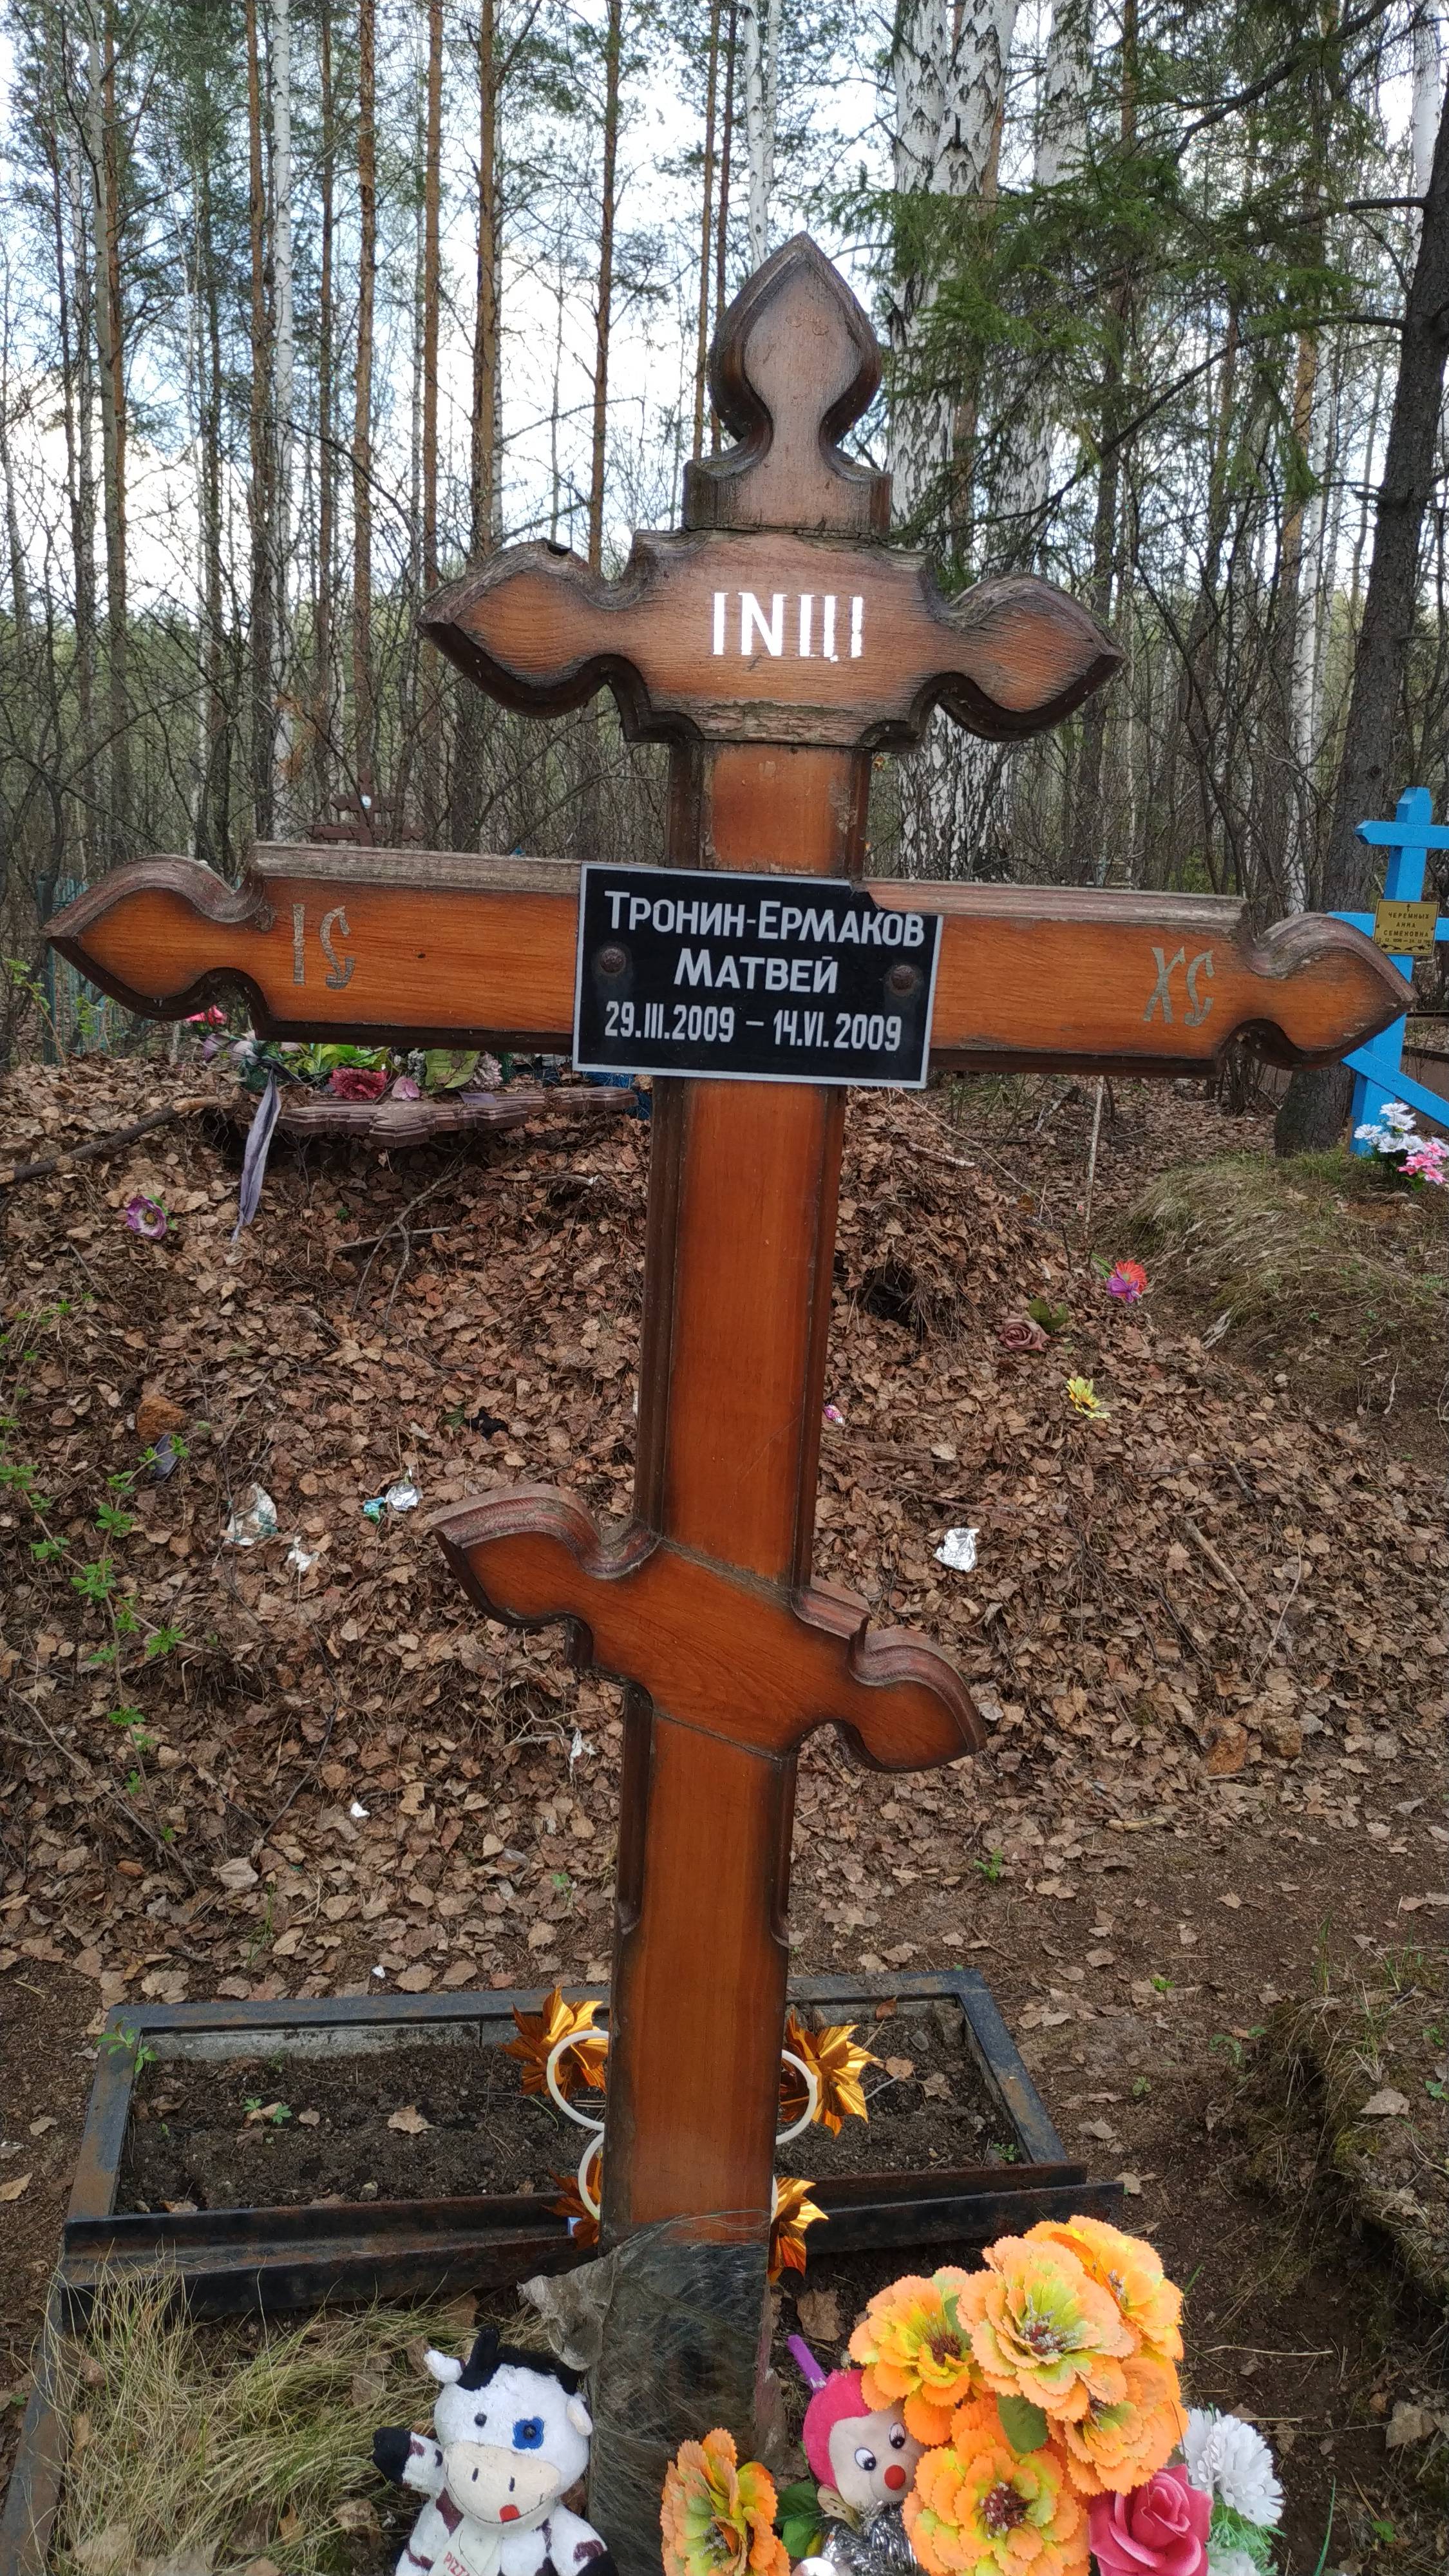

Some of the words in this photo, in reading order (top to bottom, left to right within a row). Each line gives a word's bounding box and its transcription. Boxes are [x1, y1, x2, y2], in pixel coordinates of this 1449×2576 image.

[604, 890, 925, 947] ТРОНИН-ЕРМАКОВ
[673, 947, 838, 994] МАТВЕЙ
[604, 1001, 735, 1043] 29.III.2009
